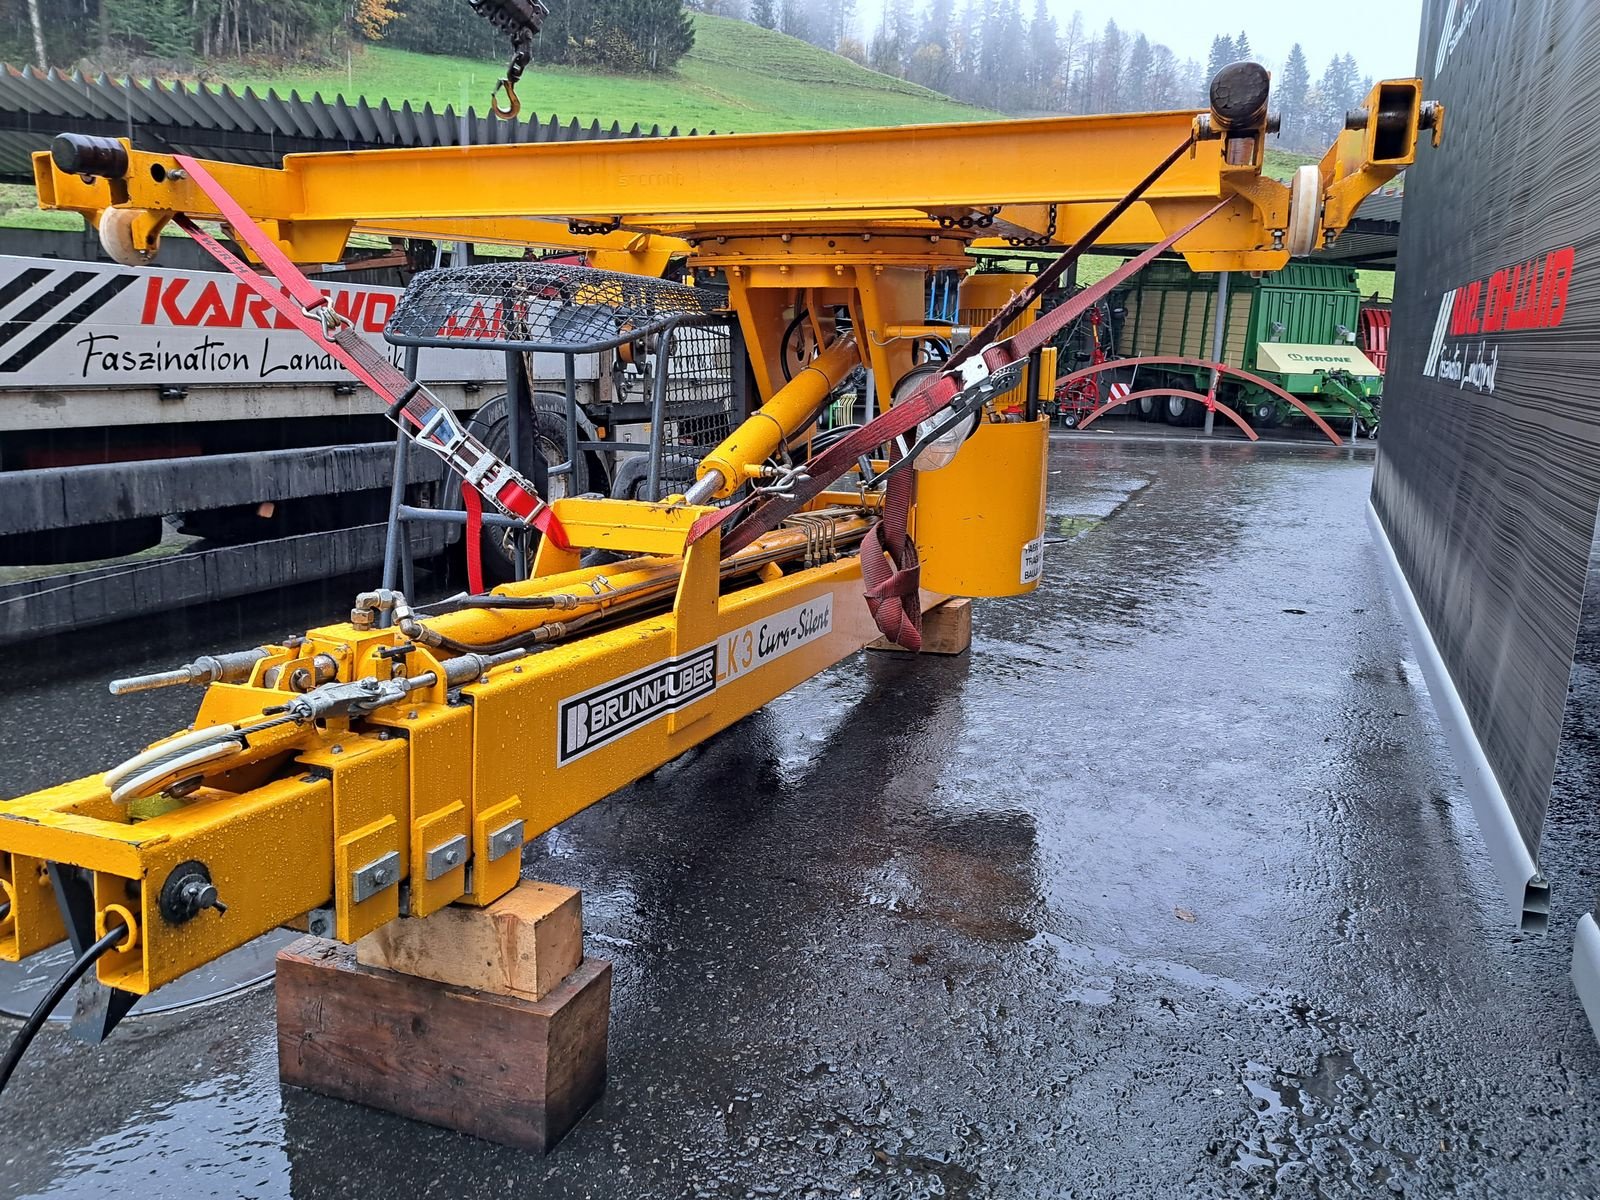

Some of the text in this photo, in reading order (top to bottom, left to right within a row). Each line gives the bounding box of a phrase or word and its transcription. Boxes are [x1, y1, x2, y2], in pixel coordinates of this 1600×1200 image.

[77, 332, 405, 378] Faszination Landik
[741, 630, 753, 668] 3
[758, 604, 829, 658] Euro-Silent
[591, 658, 714, 733] BRUNNHUBER
